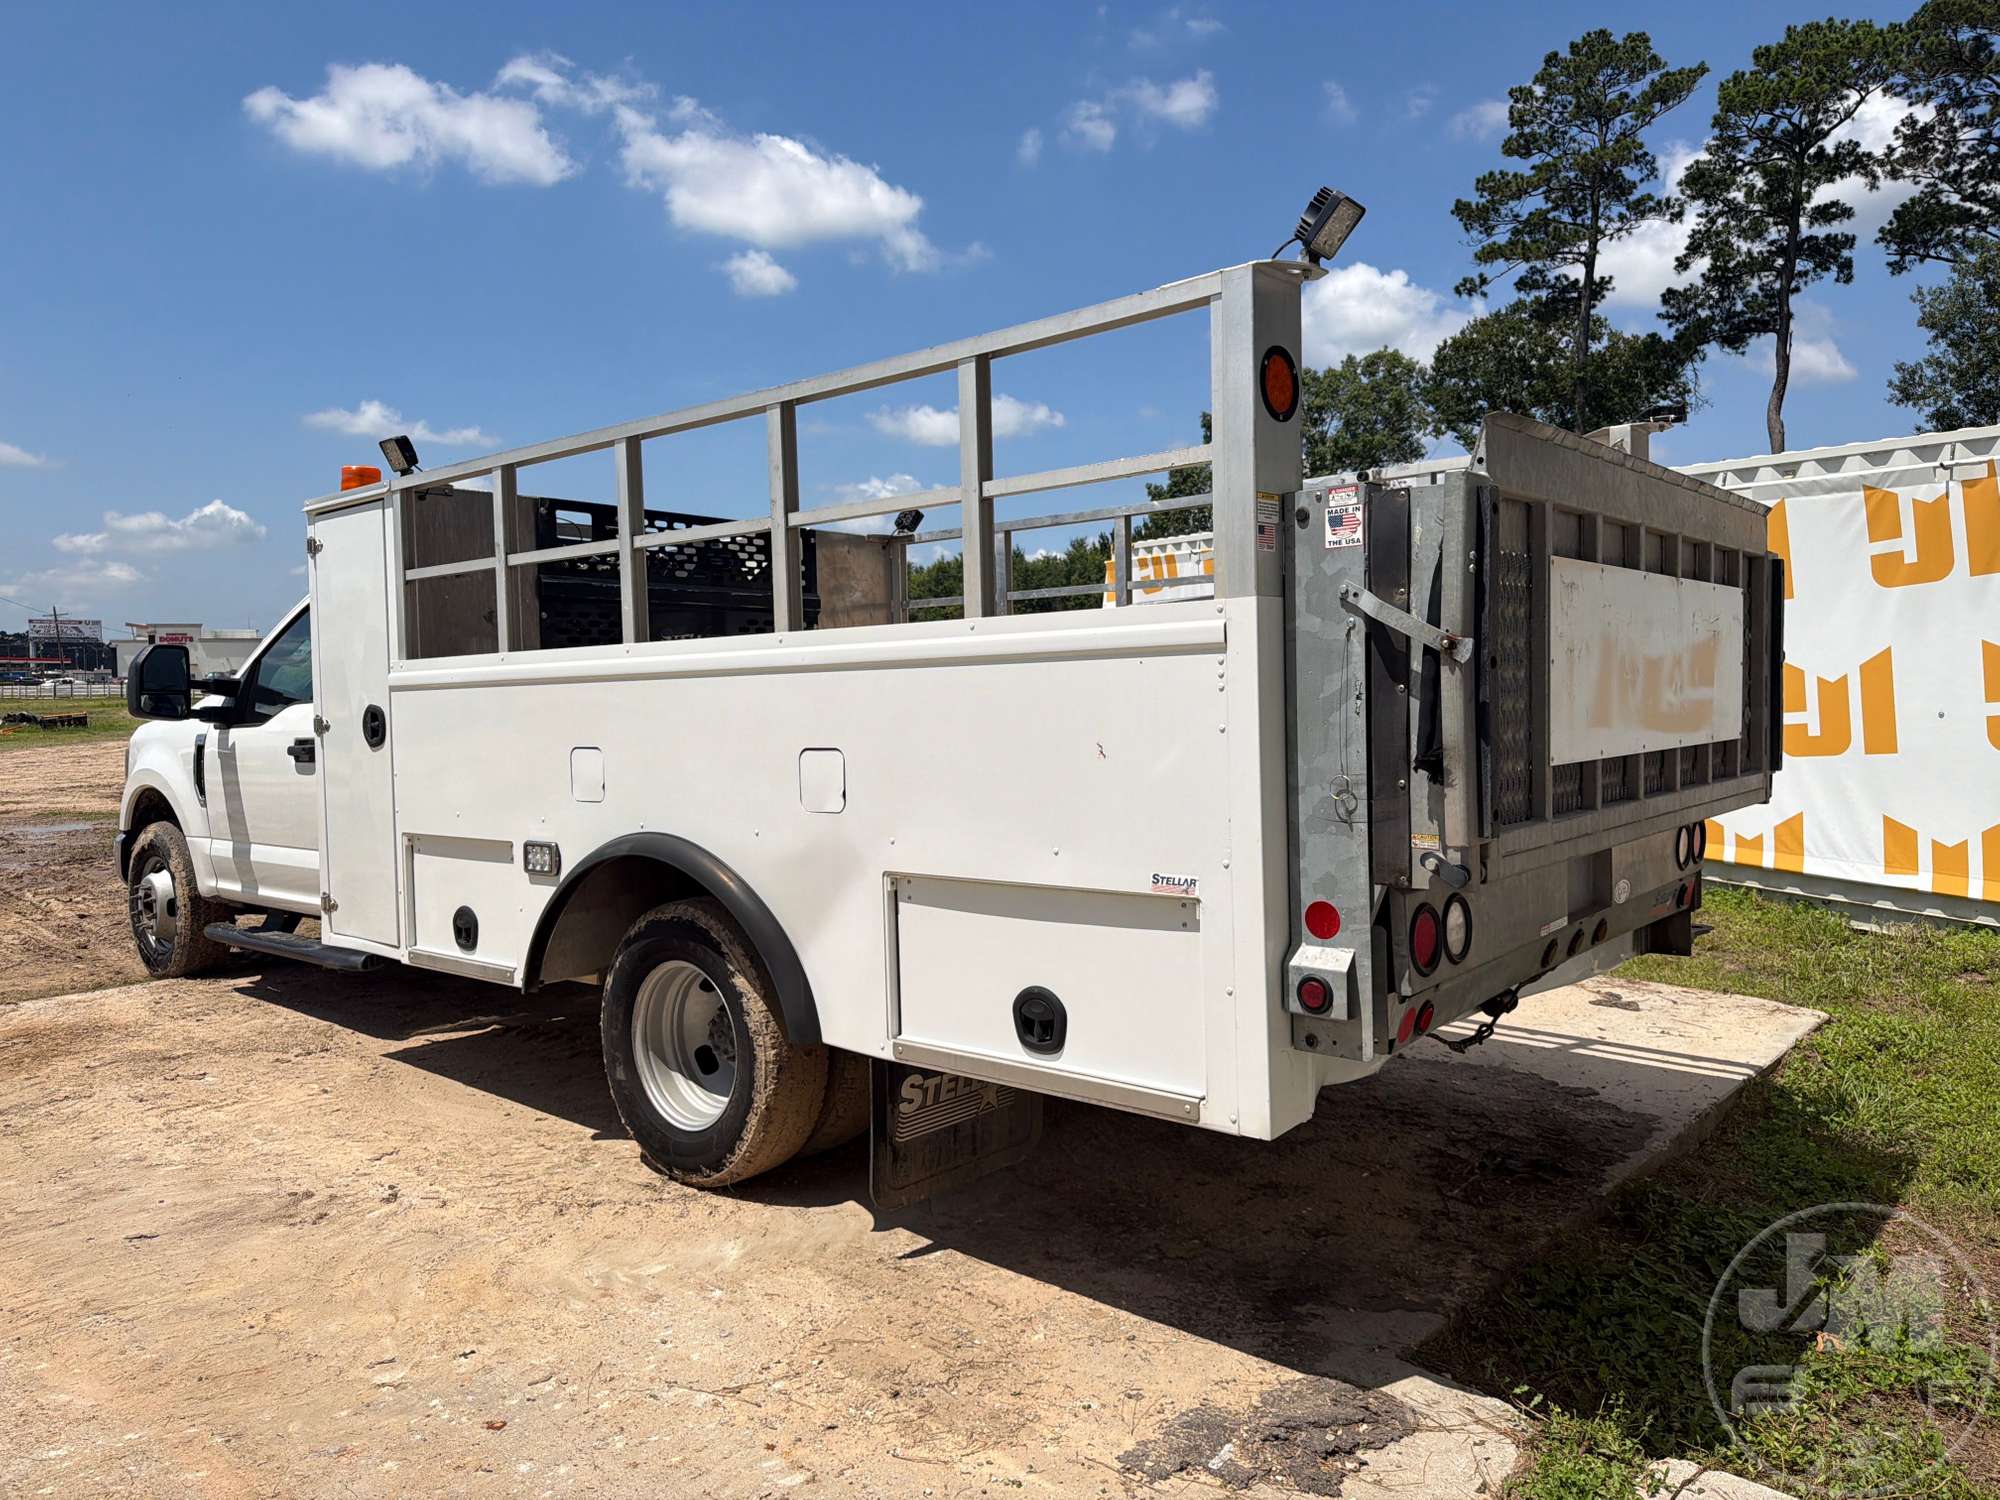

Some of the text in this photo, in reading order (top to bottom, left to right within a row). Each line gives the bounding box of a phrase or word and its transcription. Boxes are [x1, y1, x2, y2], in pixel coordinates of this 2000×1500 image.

[1327, 507, 1350, 515] MADE
[1345, 537, 1361, 545] USA
[1152, 873, 1197, 888] STELLAR
